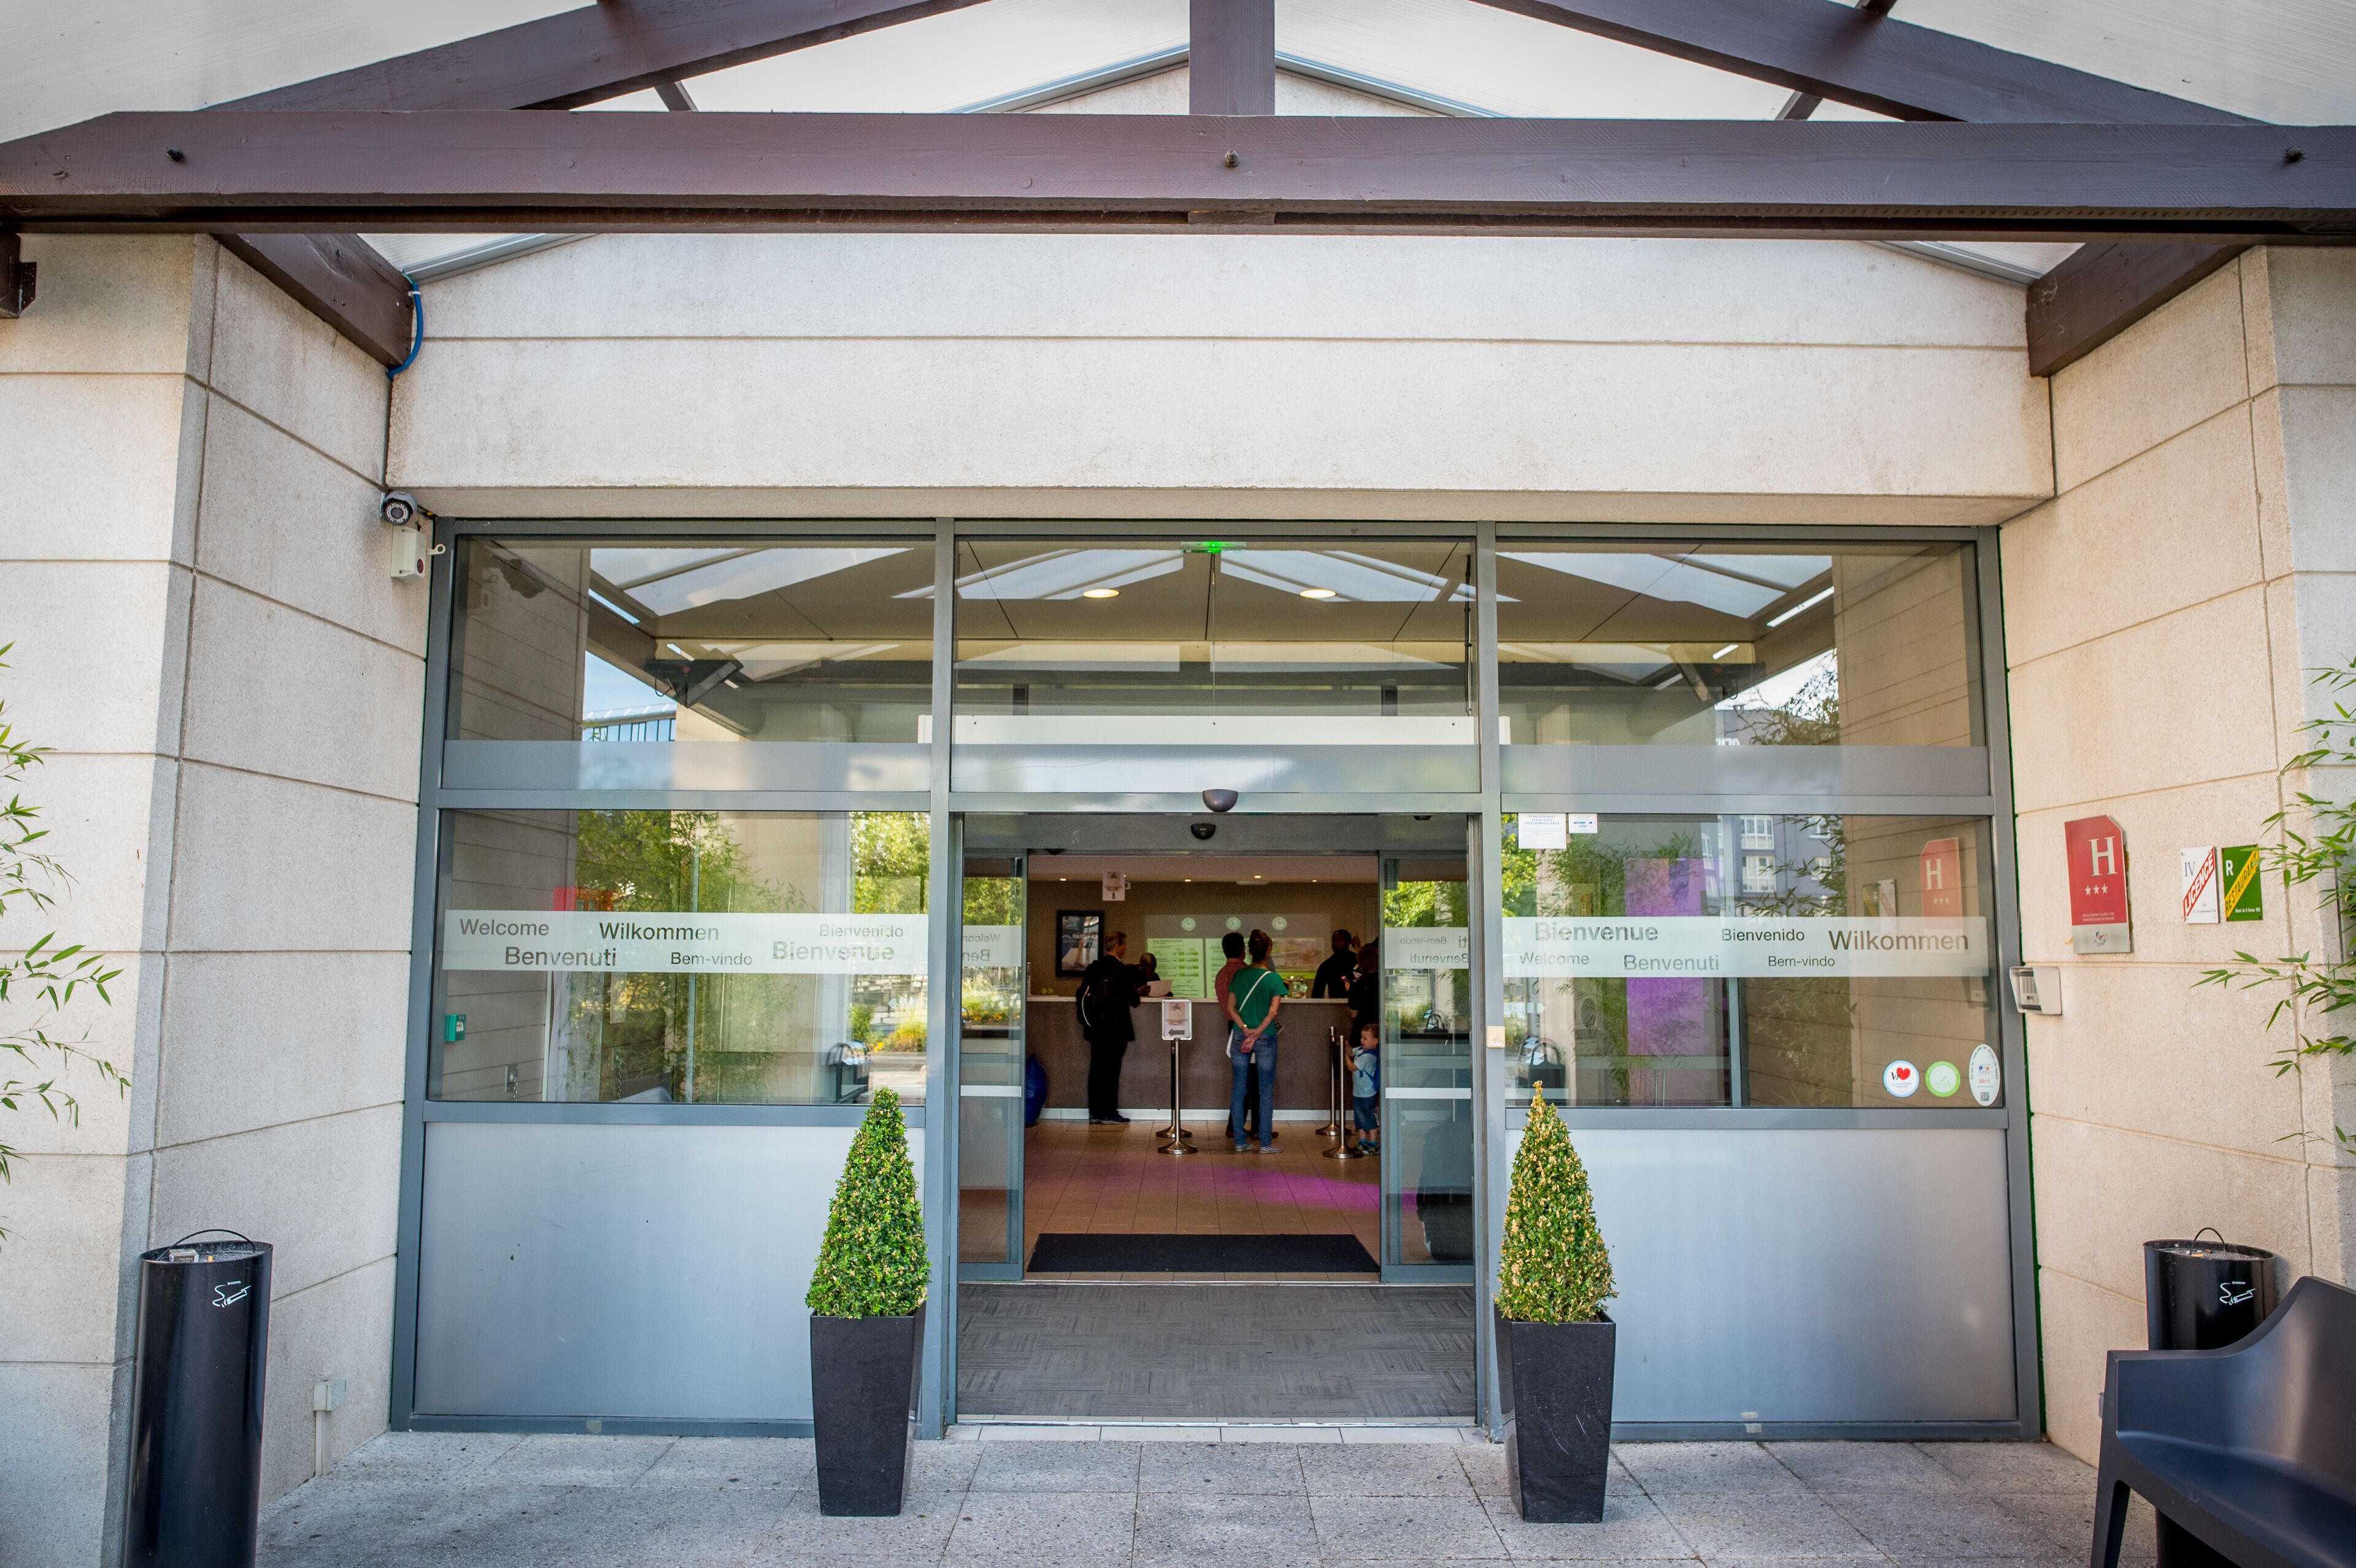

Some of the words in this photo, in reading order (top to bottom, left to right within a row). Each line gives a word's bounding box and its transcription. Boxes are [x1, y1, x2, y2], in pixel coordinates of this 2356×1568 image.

[2088, 836, 2119, 877] H
[2225, 859, 2234, 877] R
[2184, 861, 2195, 877] IV
[2184, 851, 2214, 917] LICENCE
[460, 918, 550, 936] Welcome
[599, 922, 719, 940] Wilkommen
[820, 924, 904, 938] Bienvenido
[1534, 921, 1658, 941] Bienvenue
[1722, 928, 1805, 942] Bienvenido
[1828, 930, 1969, 950] Wilkommen
[505, 945, 617, 967] Benvenuti
[671, 952, 753, 966] Bem-vindo
[772, 941, 895, 961] Bienvenue
[1520, 951, 1590, 966] Welcome
[1623, 954, 1719, 971] Benvenuti
[1768, 956, 1836, 967] Bem-vindo
